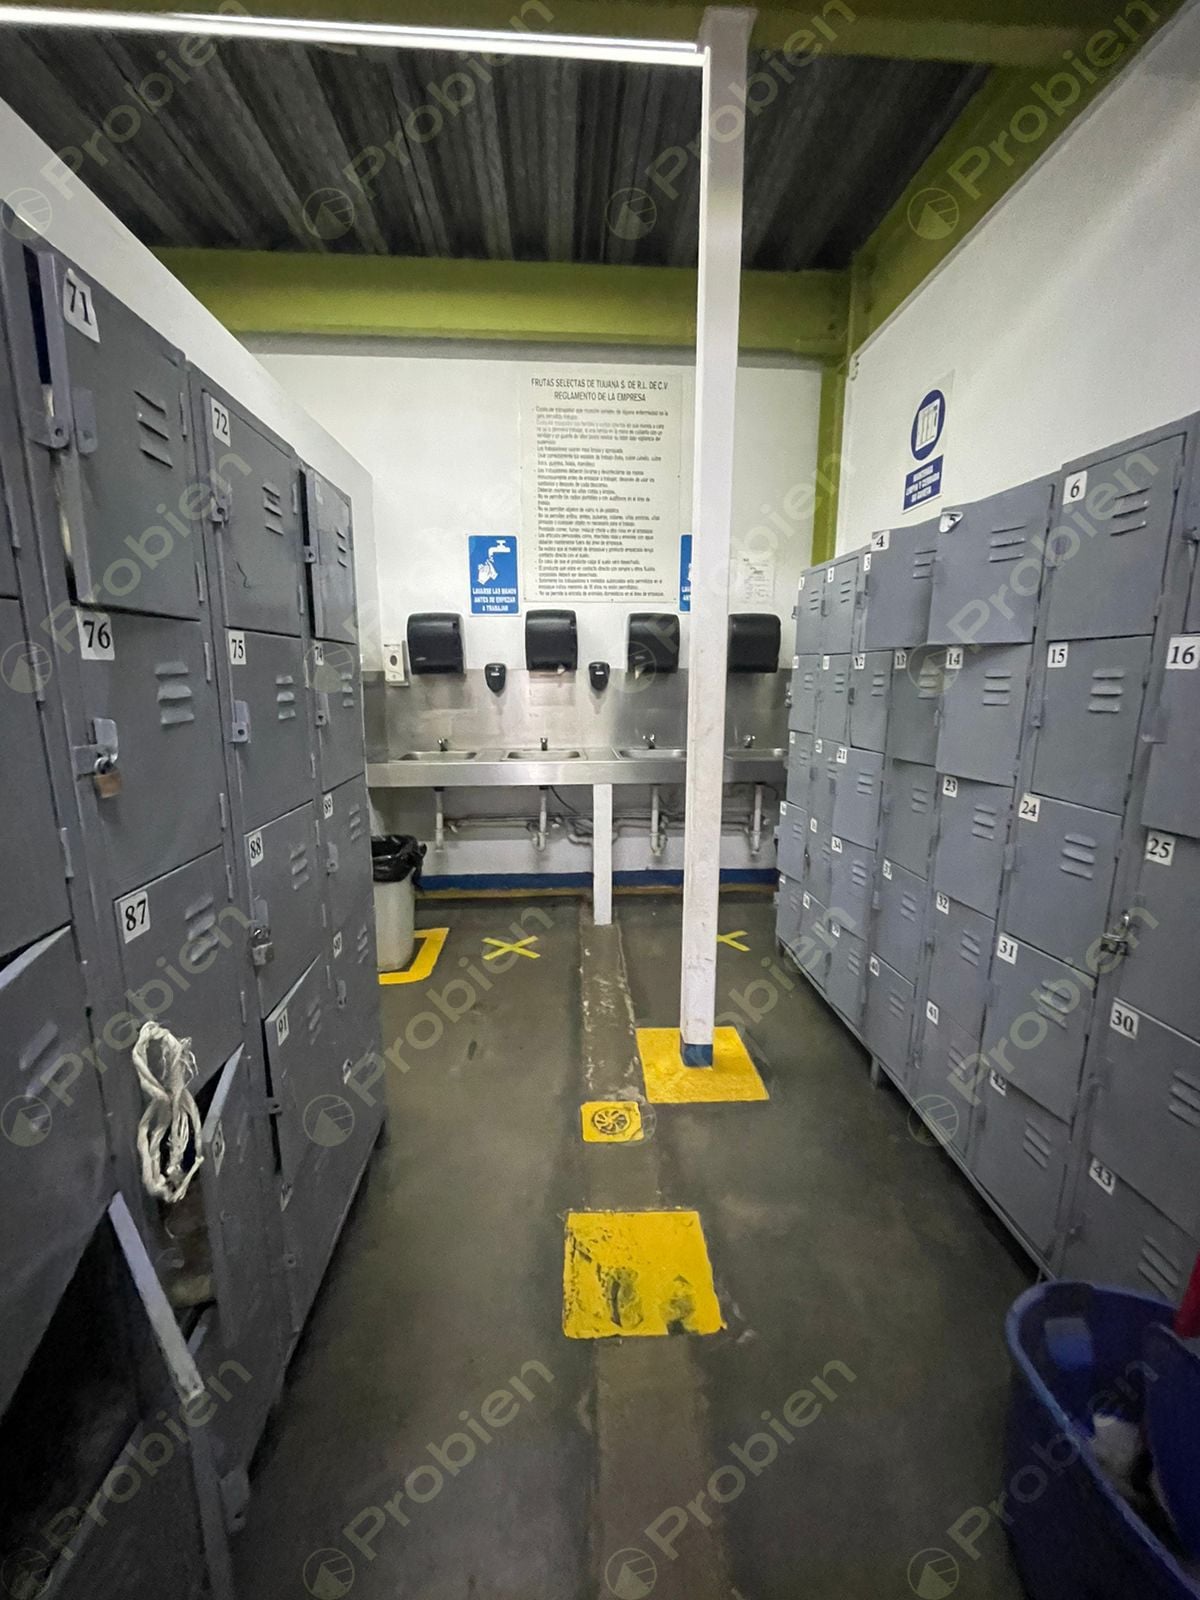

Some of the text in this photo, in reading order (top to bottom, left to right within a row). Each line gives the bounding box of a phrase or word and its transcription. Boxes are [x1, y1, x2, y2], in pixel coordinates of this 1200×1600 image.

[67, 278, 92, 325] 71
[531, 378, 554, 387] FRUTAS
[556, 378, 585, 388] SELECTAS
[586, 379, 595, 388] DE
[596, 379, 619, 389] TIJUANA
[627, 380, 636, 389] DE
[649, 381, 657, 390] DE
[554, 391, 646, 401] REGLAMENTO DE LA EMPRESA
[214, 408, 228, 435] 72
[1069, 481, 1080, 499] 6
[875, 535, 885, 548] 4
[83, 620, 111, 650] 76
[231, 639, 244, 659] 75
[947, 651, 961, 666] 14
[1051, 648, 1066, 663] 15
[1171, 645, 1196, 664] 16
[895, 653, 906, 667] 13
[944, 779, 957, 793] 23
[1022, 801, 1037, 817] 24
[250, 840, 262, 859] 88
[1147, 839, 1171, 859] 25
[937, 895, 948, 910] 32
[125, 899, 147, 932] 87
[999, 940, 1015, 960] 31
[278, 1014, 287, 1034] 91
[1113, 1011, 1135, 1034] 30
[1093, 1160, 1112, 1184] 43
